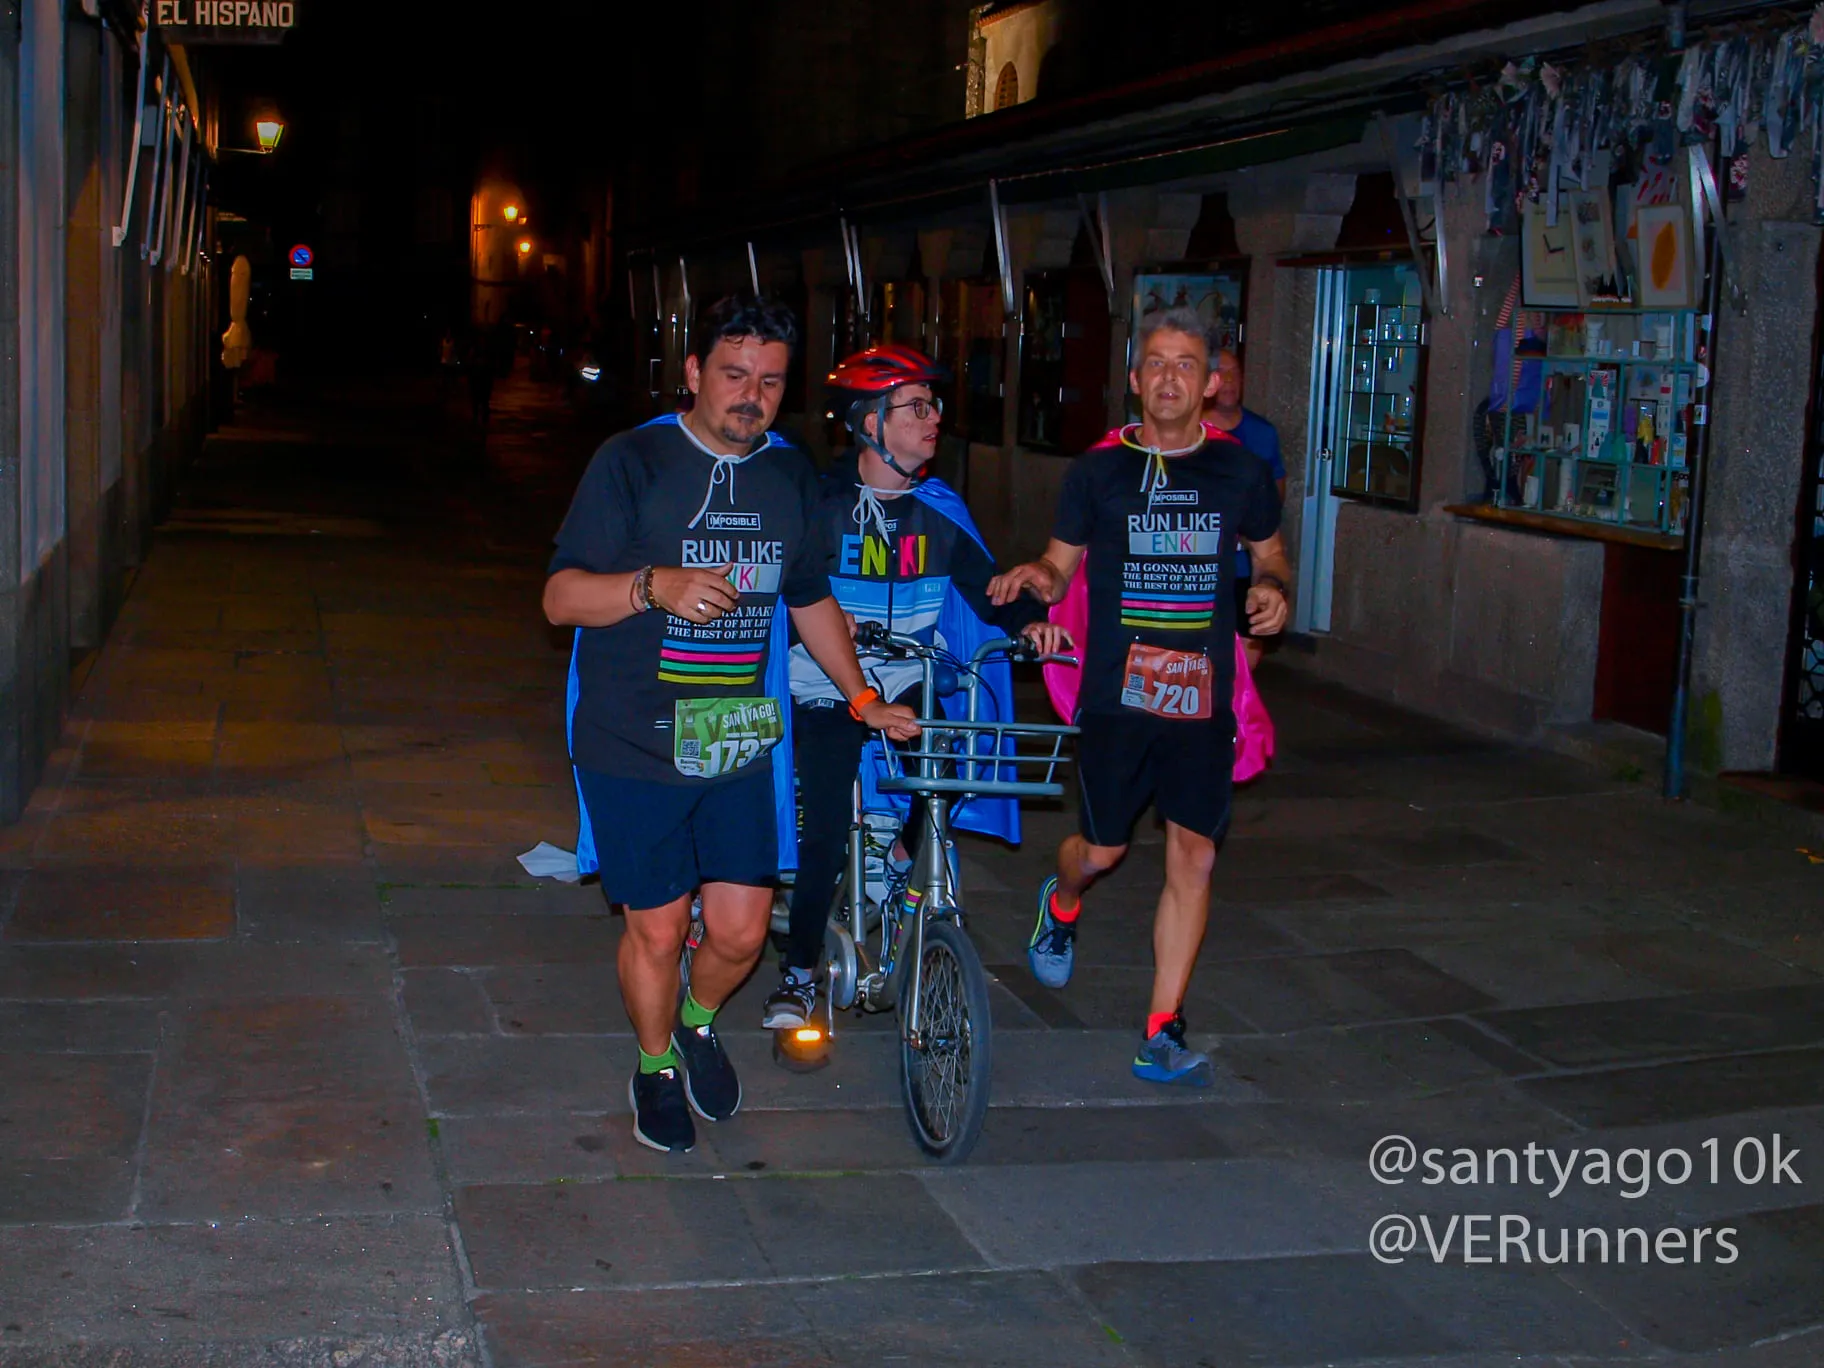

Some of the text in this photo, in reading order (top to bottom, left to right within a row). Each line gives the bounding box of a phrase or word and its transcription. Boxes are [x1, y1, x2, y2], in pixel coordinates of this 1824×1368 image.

[158, 0, 294, 27] EL HISPANO
[1127, 512, 1221, 532] RUN LIKE
[682, 539, 783, 563] RUN LIKE
[1152, 533, 1197, 553] ENKI
[840, 534, 928, 577] ENKI
[1122, 572, 1141, 580] THE
[1169, 574, 1183, 582] OF
[1183, 574, 1198, 582] MY
[1143, 563, 1187, 573] GONNA
[1188, 563, 1219, 573] MAKE
[1123, 581, 1142, 589] THE
[1144, 582, 1168, 590] BEST
[1169, 583, 1183, 591] OF
[1183, 583, 1198, 591] MY
[666, 615, 691, 627] THE
[724, 619, 739, 628] OF
[739, 619, 753, 628] MY
[666, 626, 691, 637] THE
[693, 629, 723, 639] BEST
[723, 630, 739, 639] OF
[739, 630, 753, 639] MY
[1150, 681, 1200, 715] 720
